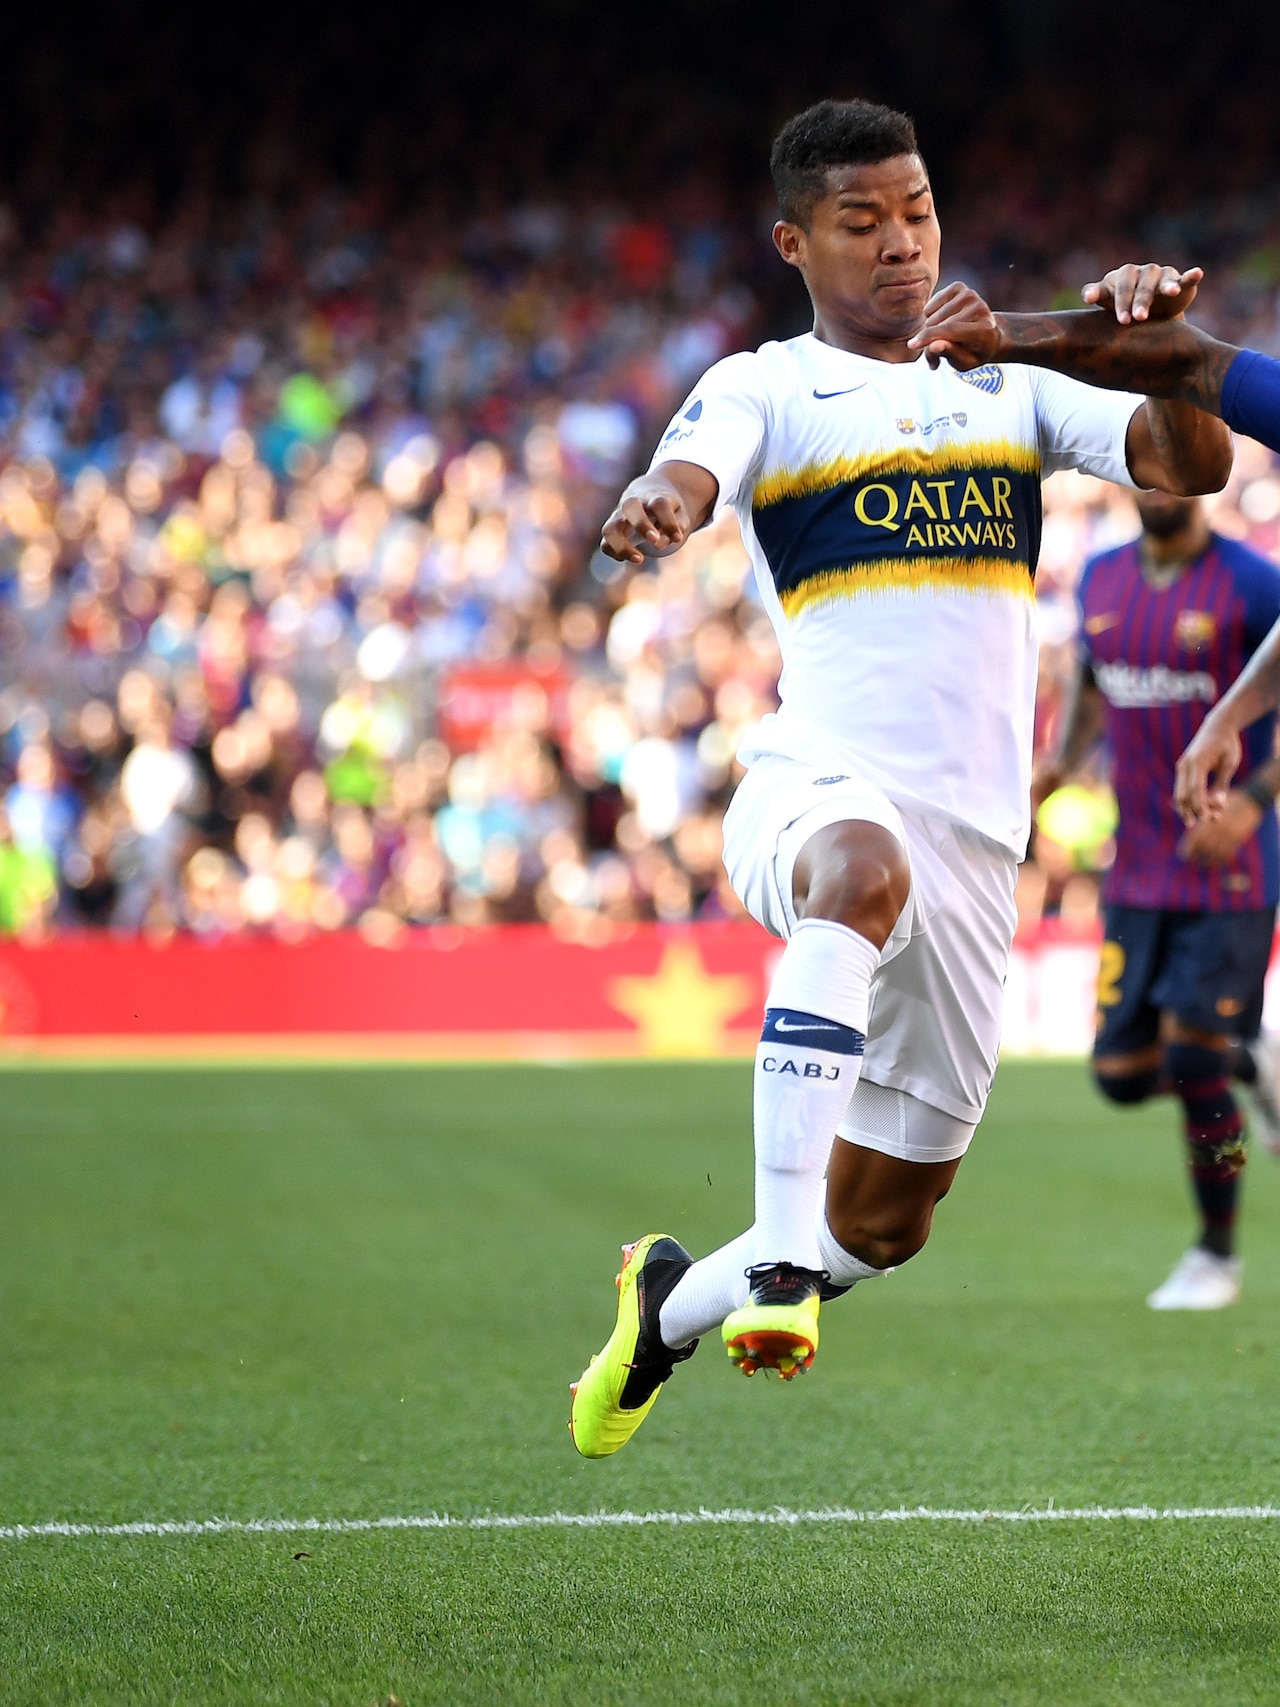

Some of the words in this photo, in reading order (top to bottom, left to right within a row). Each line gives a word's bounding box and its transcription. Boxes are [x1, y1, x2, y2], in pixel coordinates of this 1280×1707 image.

[853, 476, 1015, 531] QATAR
[905, 520, 1017, 550] AIRWAYS
[763, 1056, 841, 1081] CABJ
